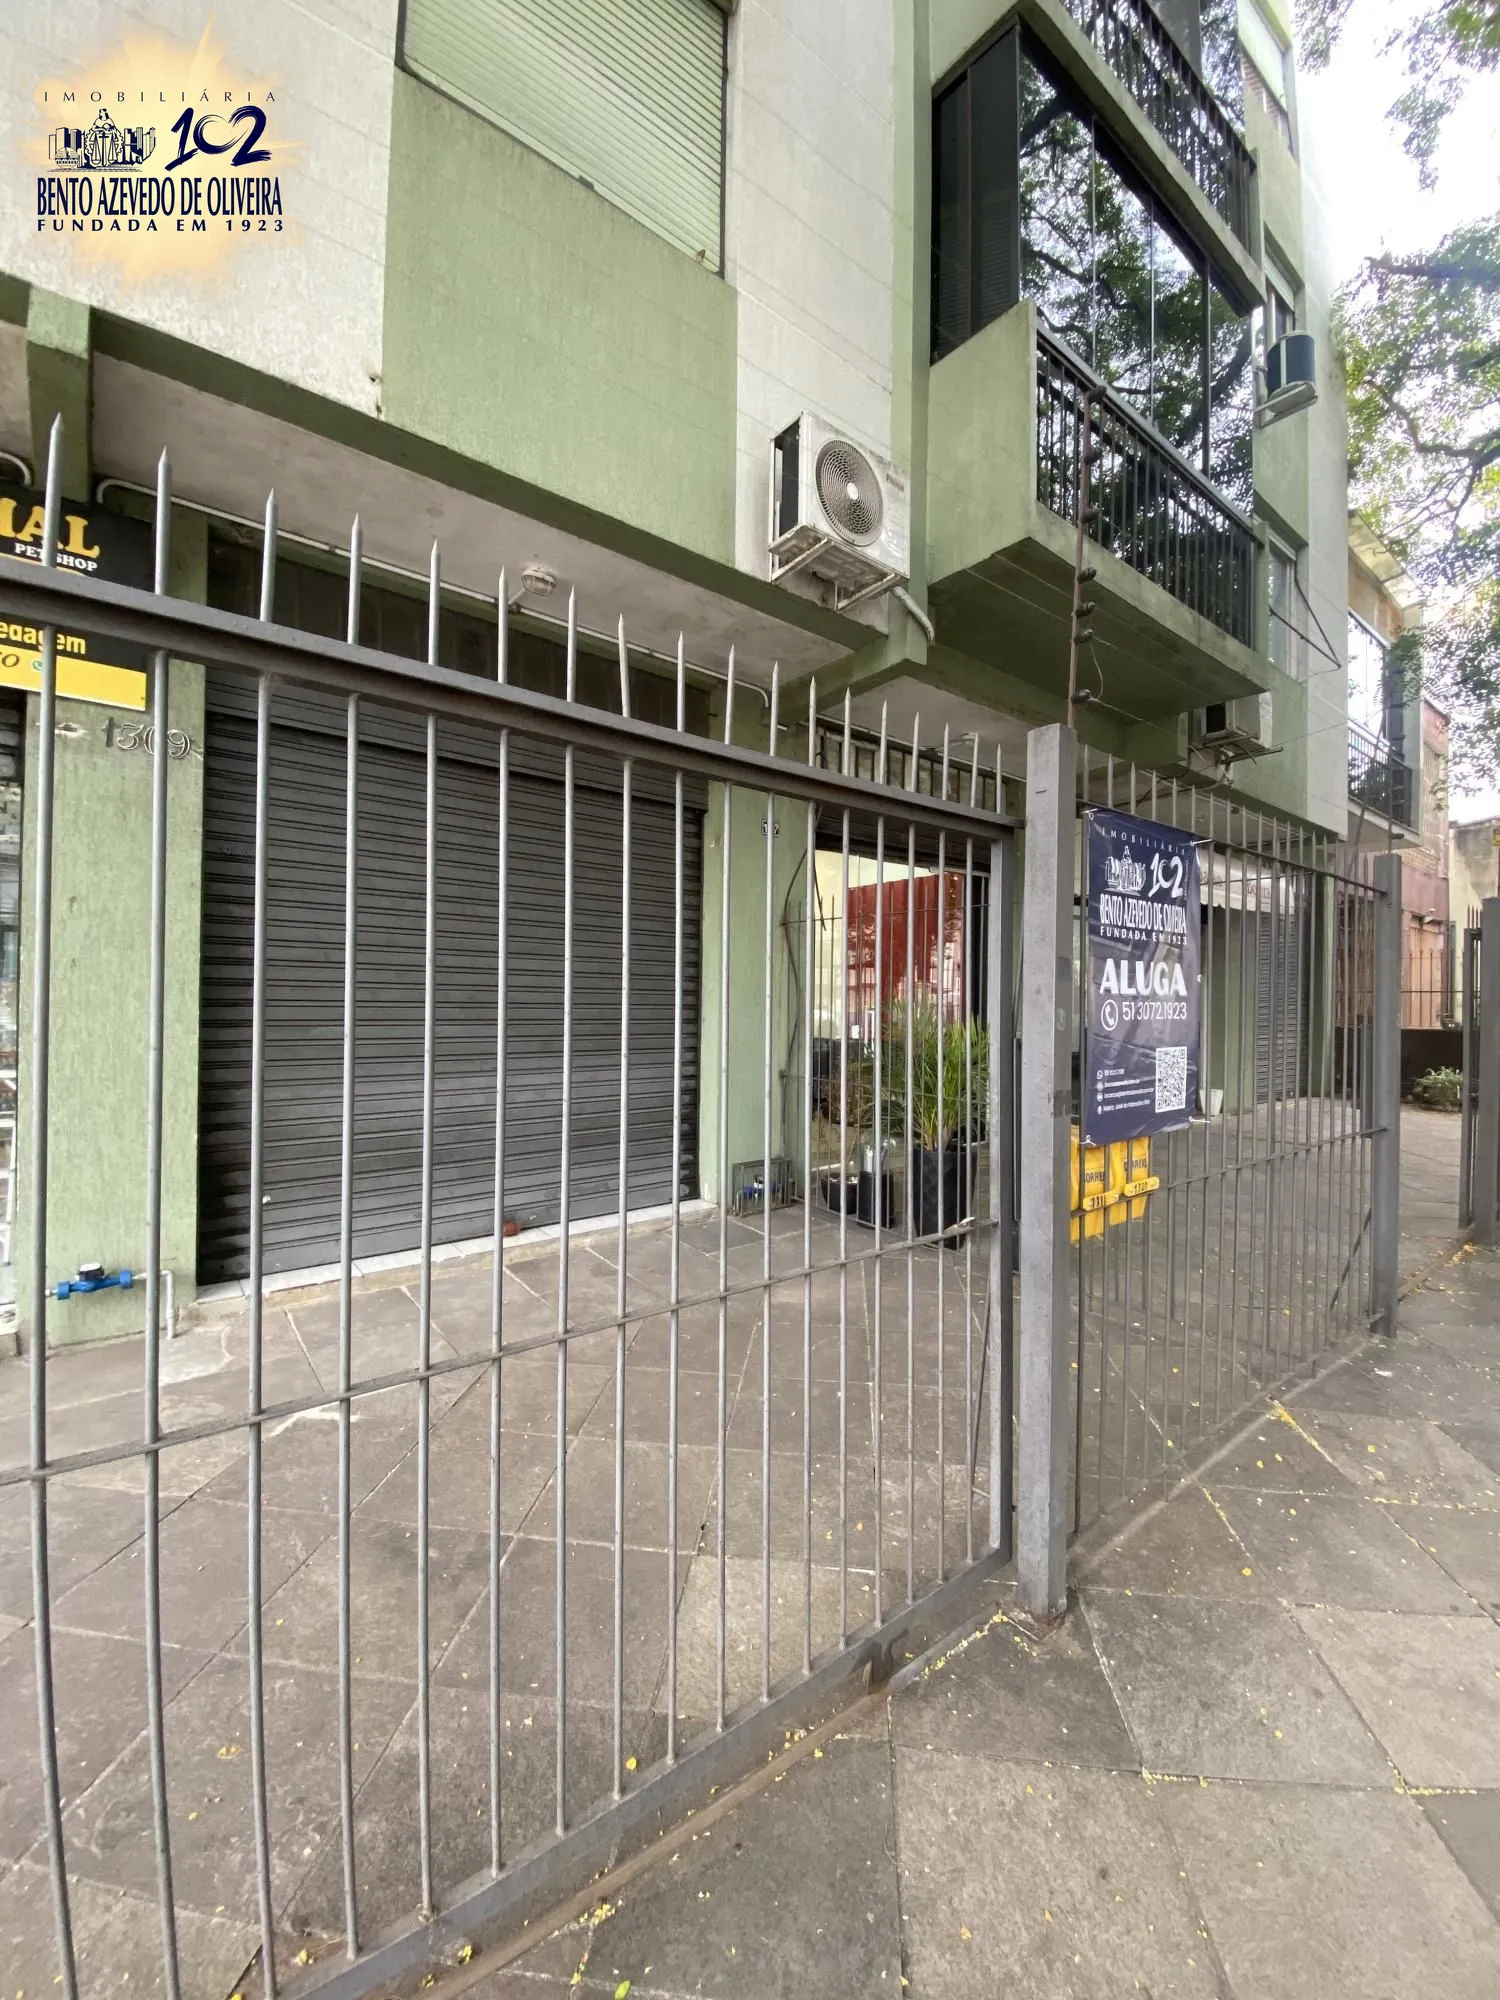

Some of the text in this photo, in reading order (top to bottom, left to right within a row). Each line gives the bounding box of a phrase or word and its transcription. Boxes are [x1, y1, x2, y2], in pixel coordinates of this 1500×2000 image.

[1148, 852, 1184, 898] 102
[1100, 893, 1123, 926] BENTO
[1123, 897, 1153, 930] AZEVEDO
[1153, 902, 1164, 931] DE
[1100, 926, 1146, 941] FUNDADA
[1168, 934, 1187, 945] 1923
[1100, 958, 1188, 996] ALUGA
[1122, 1001, 1135, 1020] 51
